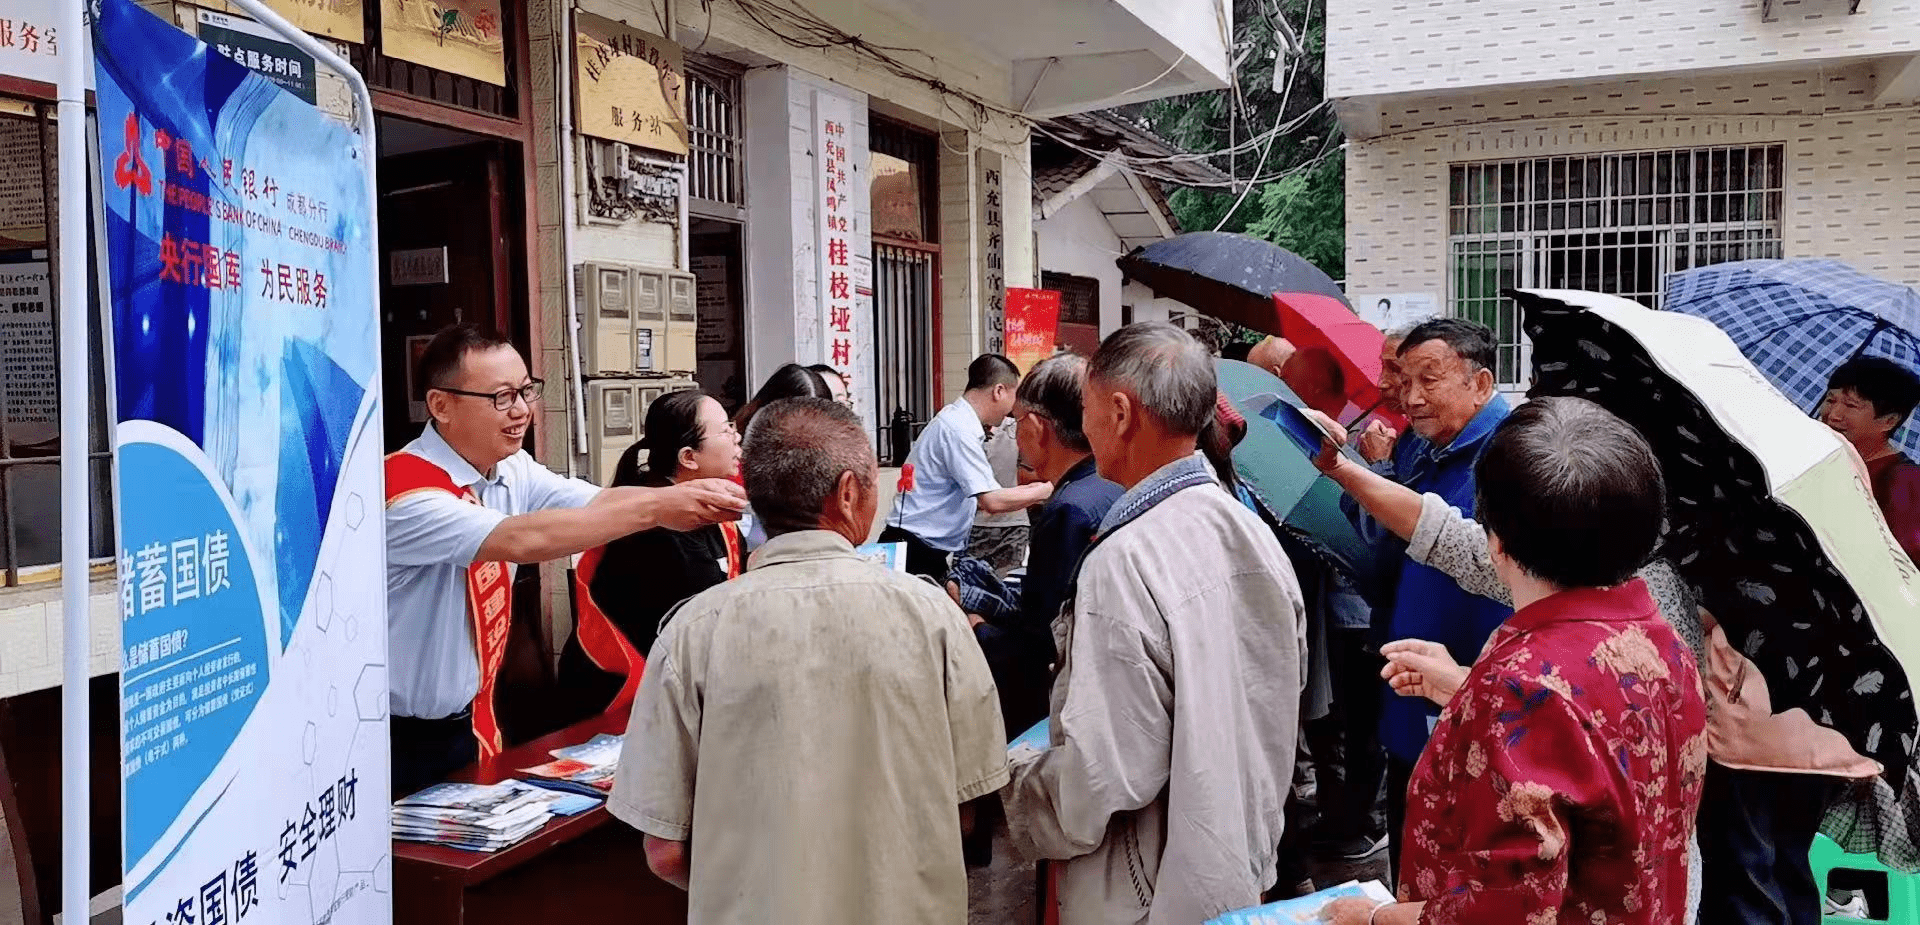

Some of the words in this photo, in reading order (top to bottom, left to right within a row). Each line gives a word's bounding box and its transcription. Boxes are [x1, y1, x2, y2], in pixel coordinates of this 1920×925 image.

[611, 106, 662, 136] 服务站
[154, 128, 280, 208] 中国人民银行
[835, 122, 848, 232] 中国共产党
[223, 201, 245, 225] BANK
[245, 210, 257, 231] OF
[257, 213, 283, 237] CHINA
[288, 226, 324, 249] CHENGDU
[159, 232, 242, 294] 央行国库
[261, 258, 328, 309] 为民服务
[278, 768, 358, 884] 安全理财
